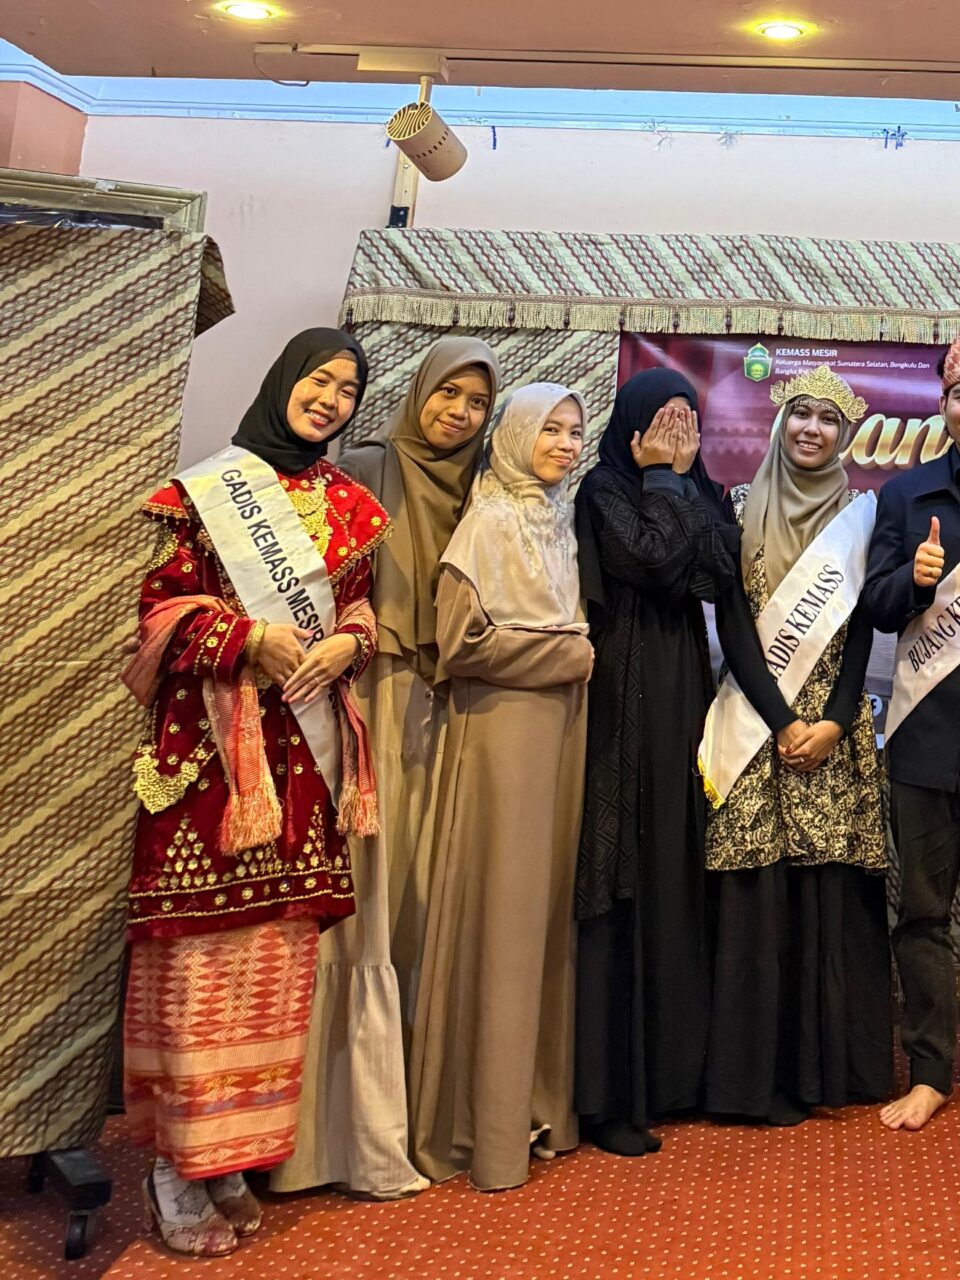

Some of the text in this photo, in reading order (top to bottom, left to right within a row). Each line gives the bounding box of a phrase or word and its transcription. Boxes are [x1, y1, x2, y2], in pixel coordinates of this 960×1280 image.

[775, 348, 838, 358] KEMASS MESIR
[775, 359, 802, 367] Keluarga
[890, 361, 917, 369] Bengkulu
[221, 469, 324, 649] GADIS KEMASS MESIR
[765, 564, 844, 682] ADIS KEMASS
[907, 614, 956, 673] BUJANG
